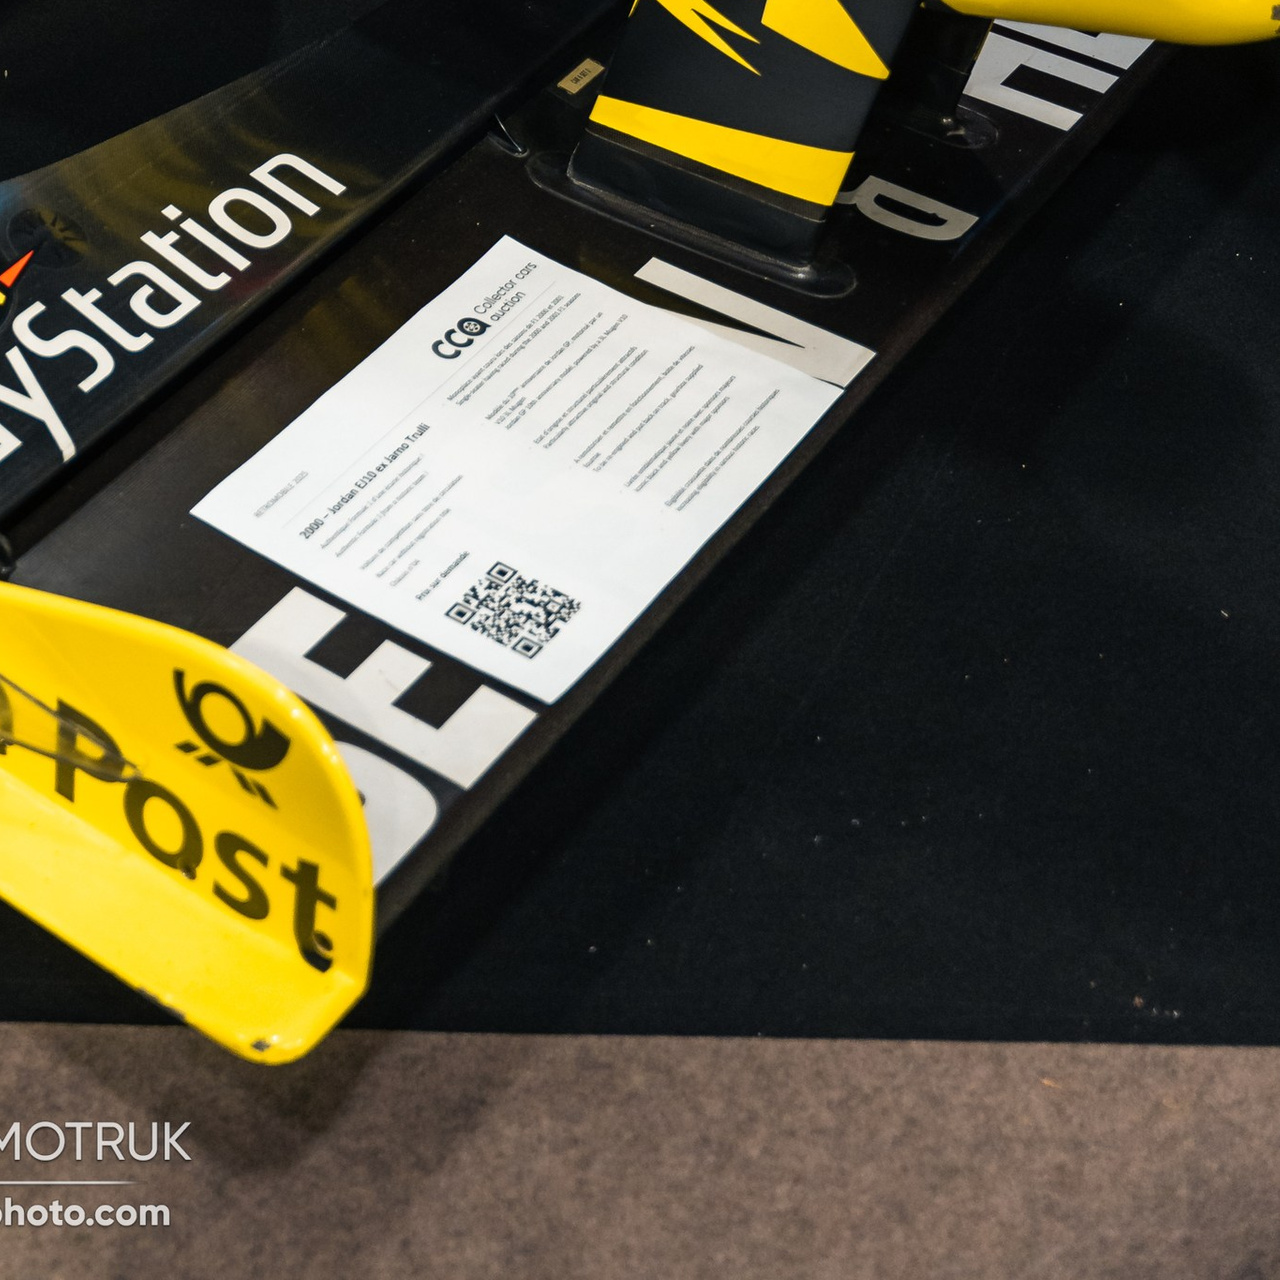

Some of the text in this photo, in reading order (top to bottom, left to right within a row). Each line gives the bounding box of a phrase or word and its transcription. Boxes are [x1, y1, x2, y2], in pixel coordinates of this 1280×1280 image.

[473, 261, 537, 314] Collector cars
[489, 291, 525, 321] auction
[299, 518, 324, 538] 2000
[327, 489, 358, 513] Jordan
[354, 470, 377, 489] EJ10
[374, 462, 388, 472] ex
[383, 442, 409, 462] Jarno
[404, 423, 429, 442] Trulli
[53, 695, 337, 973] Post
